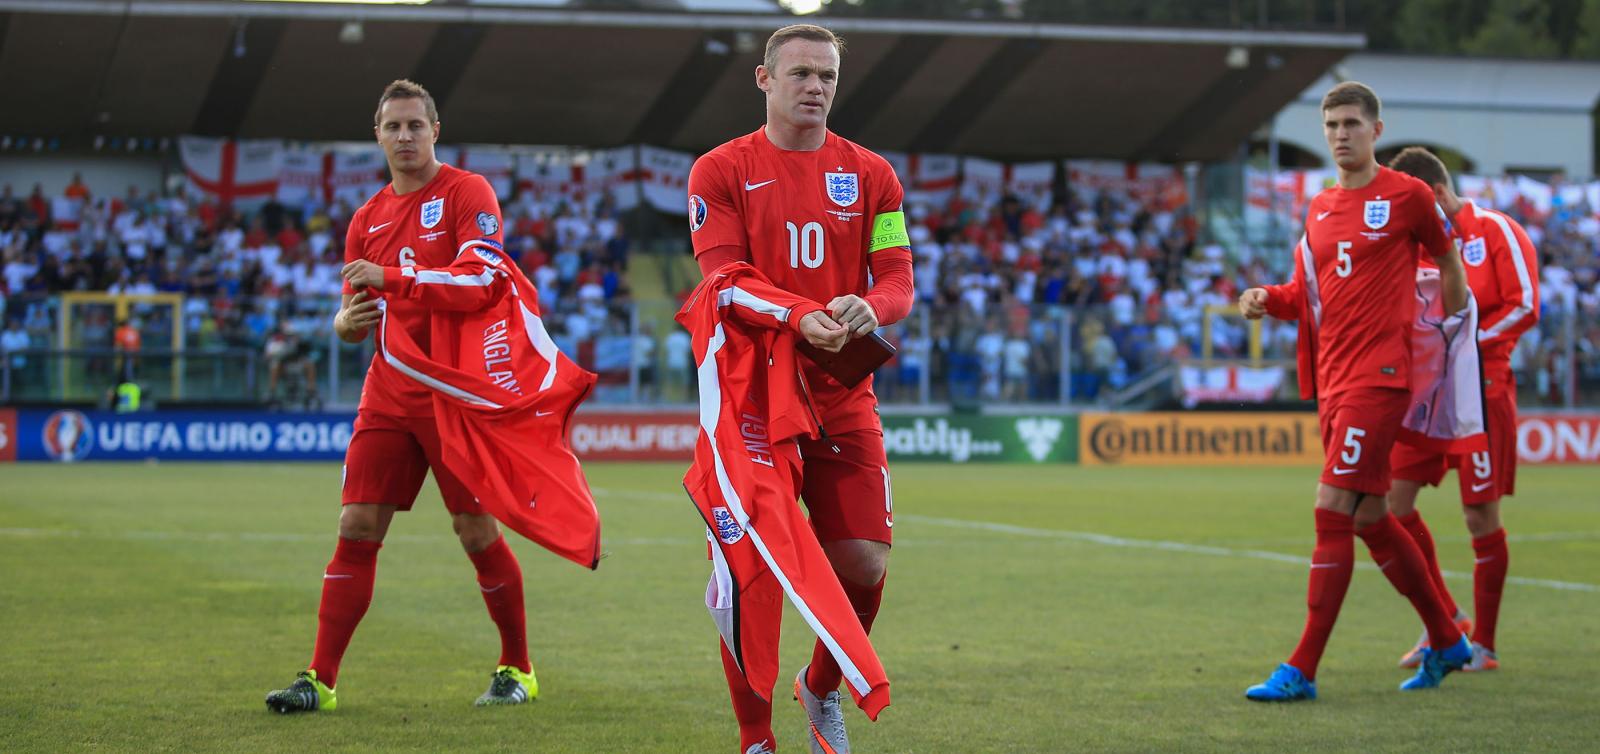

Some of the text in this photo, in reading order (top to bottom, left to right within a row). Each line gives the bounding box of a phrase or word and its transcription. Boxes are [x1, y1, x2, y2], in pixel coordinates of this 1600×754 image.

[786, 221, 824, 269] 10
[1336, 241, 1352, 278] 5
[483, 319, 523, 396] ENGLAN
[99, 421, 350, 451] UEFA EURO 2016
[741, 391, 775, 468] ENGL
[1089, 418, 1305, 464] Continental
[1341, 427, 1366, 465] 5
[1516, 419, 1600, 462] ON
[880, 465, 893, 513] 1
